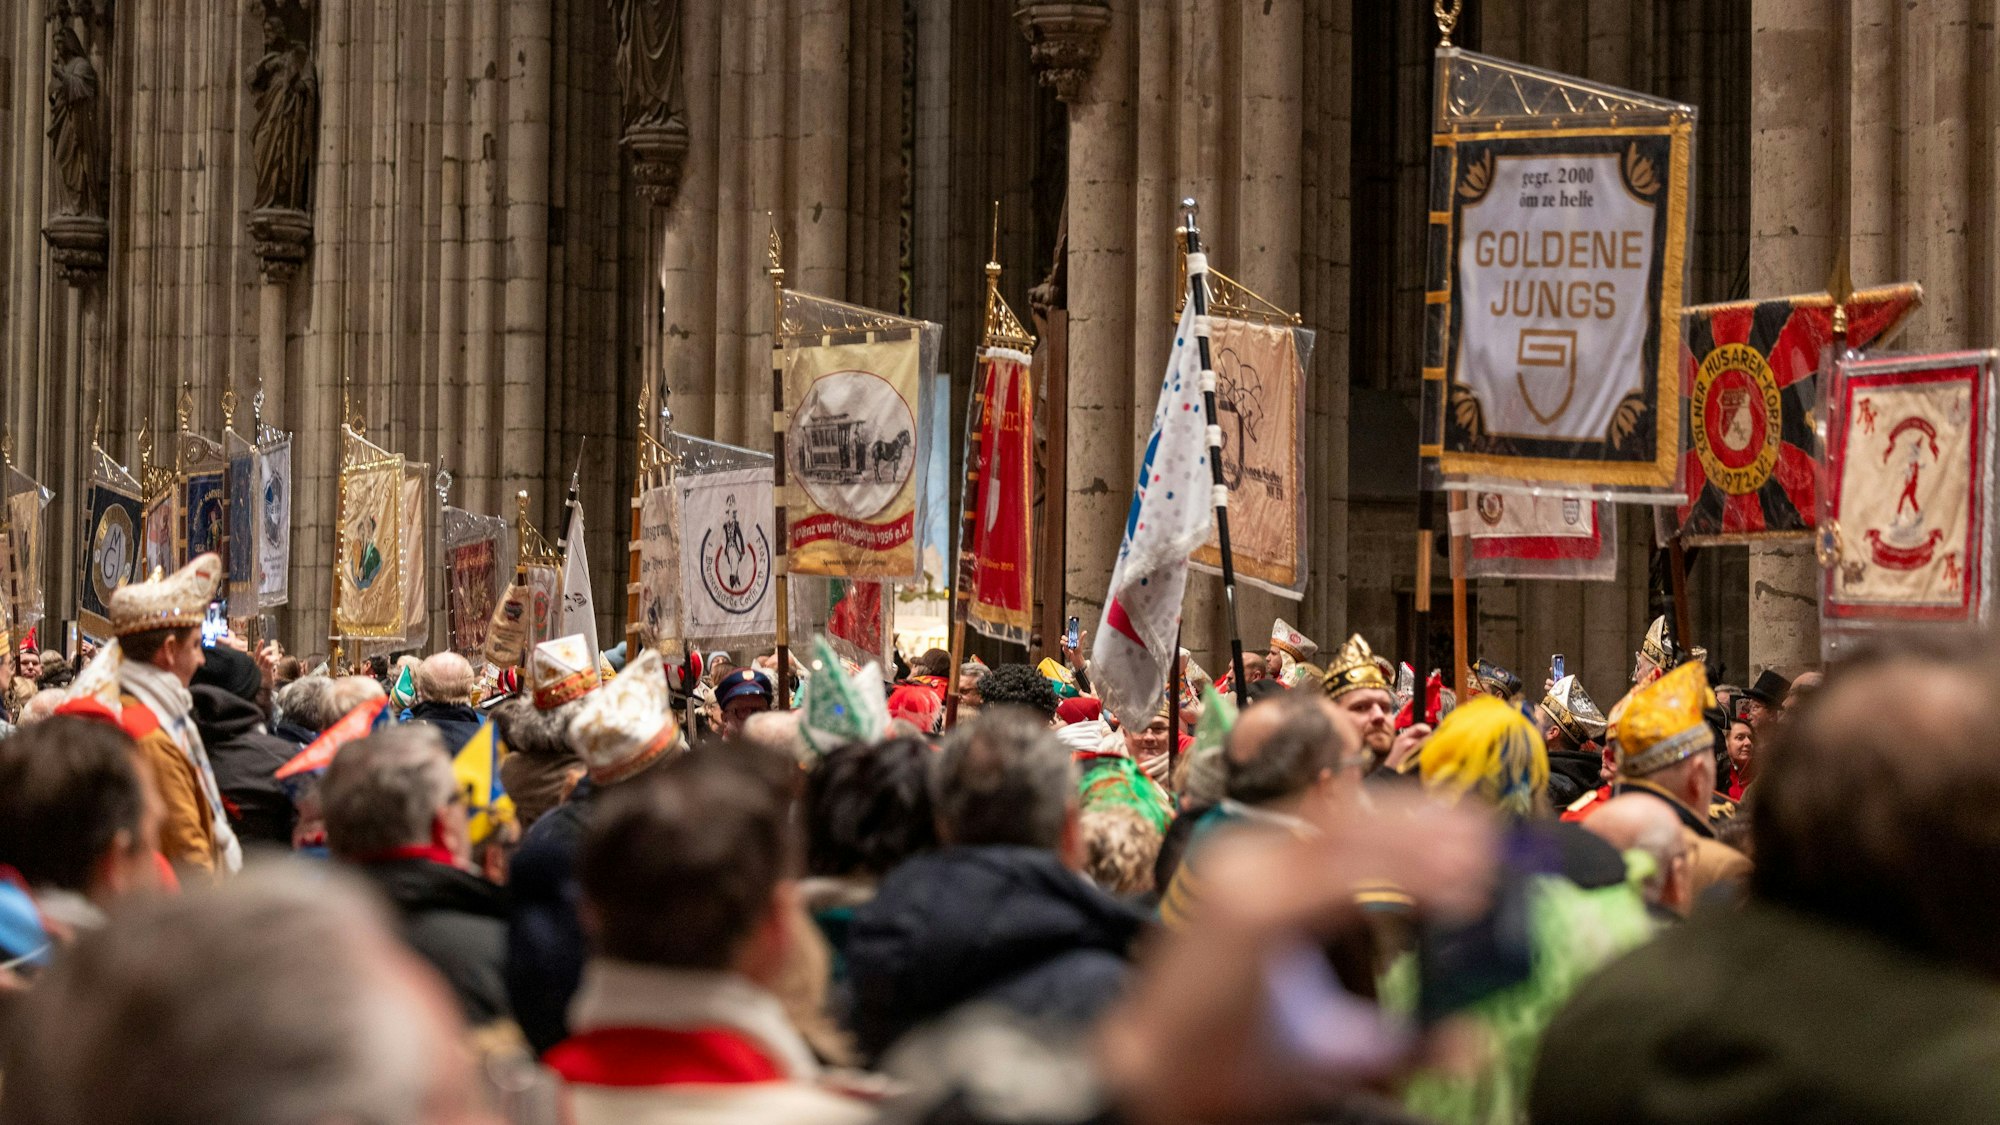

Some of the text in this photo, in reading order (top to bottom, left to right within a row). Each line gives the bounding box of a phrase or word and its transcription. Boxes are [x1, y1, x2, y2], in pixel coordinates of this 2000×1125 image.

[1522, 167, 1594, 189] gegr. 2000
[1519, 190, 1594, 208] öm ze helfe
[1475, 230, 1643, 270] GOLDENE
[1490, 280, 1616, 320] JUNGS
[1693, 381, 1708, 456] KÖLNER
[817, 522, 832, 534] vun
[876, 528, 893, 545] 1956
[895, 522, 909, 539] e.V.
